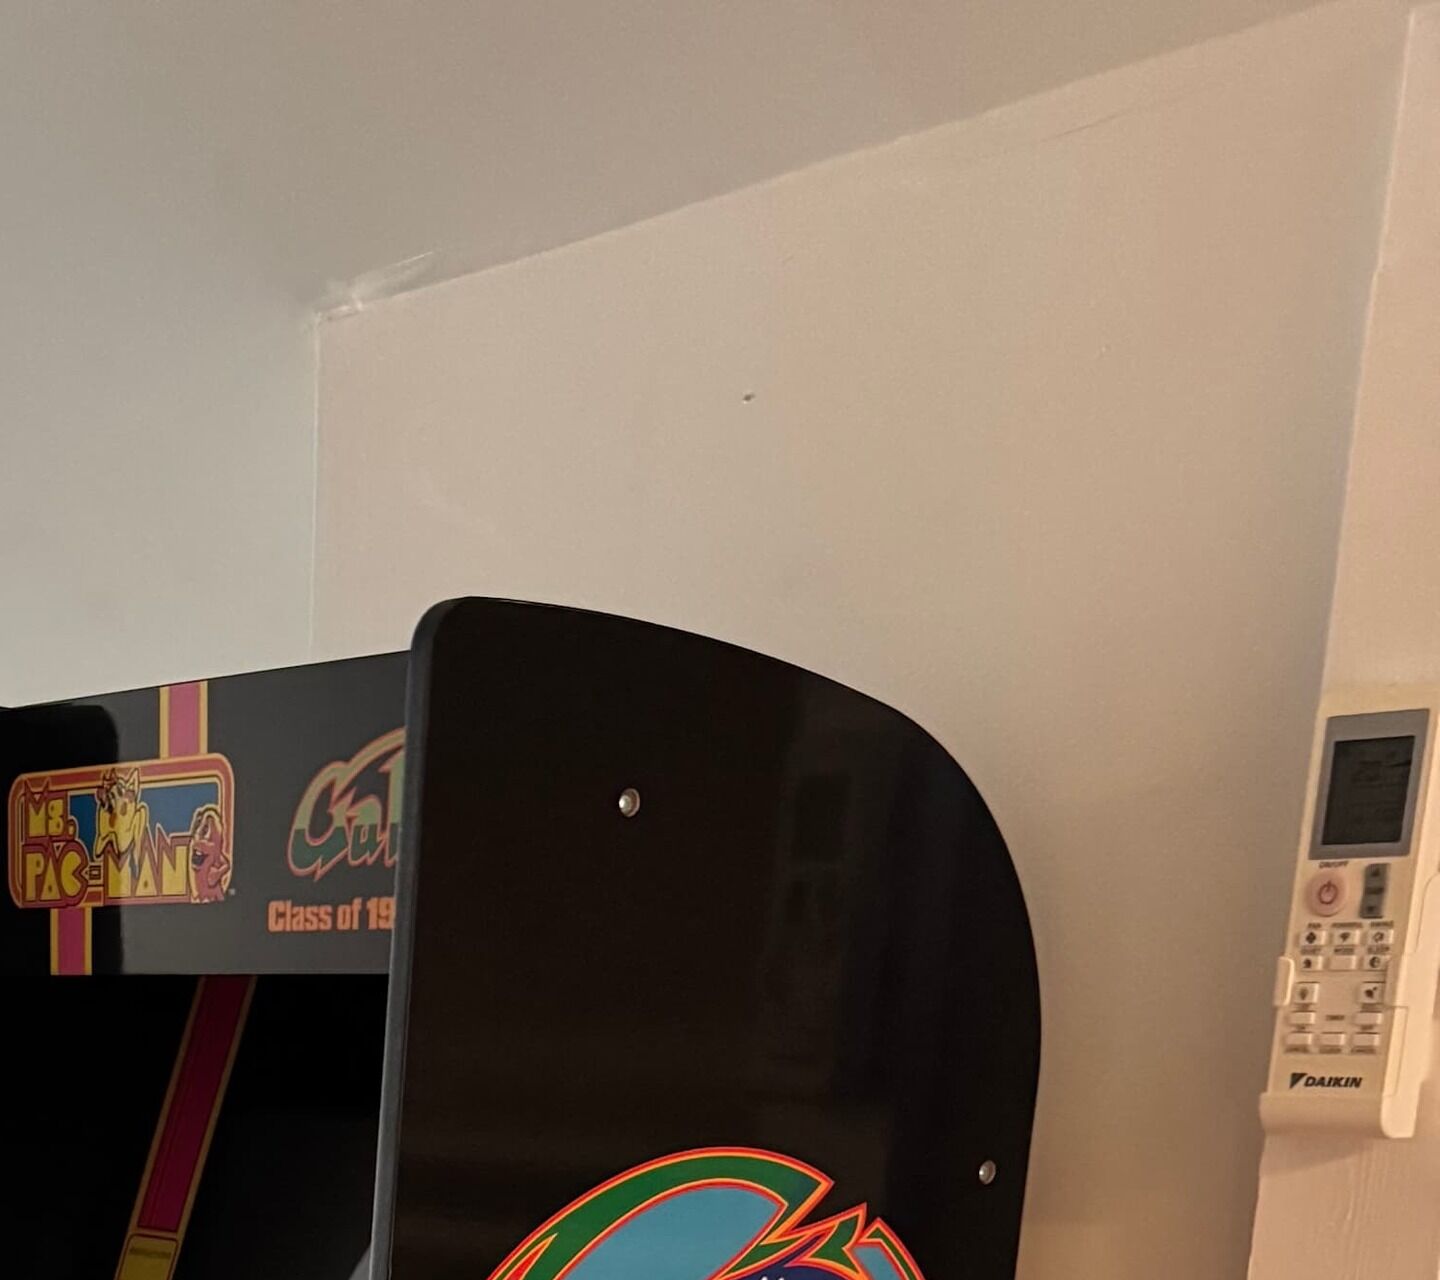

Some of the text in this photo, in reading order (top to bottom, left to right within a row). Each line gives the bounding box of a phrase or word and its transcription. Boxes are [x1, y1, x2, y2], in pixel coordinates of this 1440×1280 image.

[288, 726, 406, 882] Gal
[23, 842, 190, 902] PAC-MAN
[268, 896, 397, 932] Class of 19
[1303, 1075, 1363, 1089] DAIKIN
